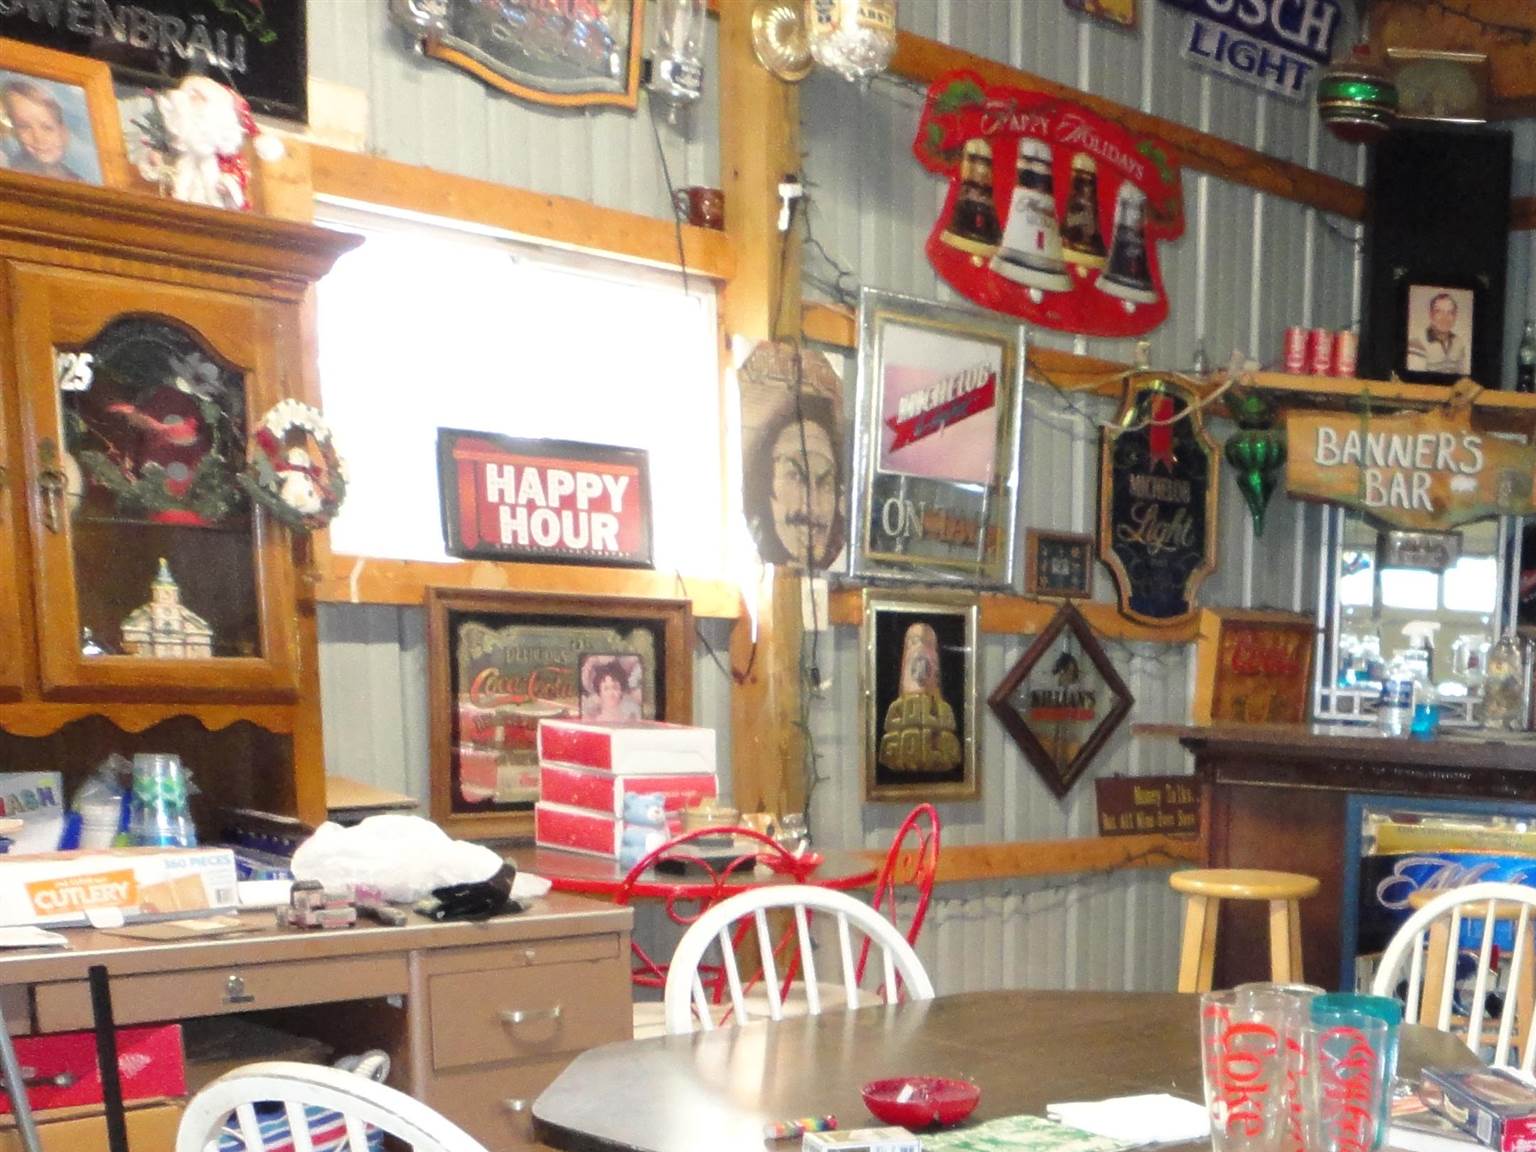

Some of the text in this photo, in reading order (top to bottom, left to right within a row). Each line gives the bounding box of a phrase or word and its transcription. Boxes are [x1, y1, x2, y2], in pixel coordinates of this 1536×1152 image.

[0, 0, 248, 75] WENBRÄU
[1189, 21, 1313, 91] LIGHT
[1315, 427, 1484, 474] BANNER'S
[486, 463, 629, 513] HAPPY
[1361, 468, 1434, 512] BAR
[499, 505, 619, 551] HOUR
[882, 497, 926, 538] ON
[34, 880, 131, 909] CUTLERY
